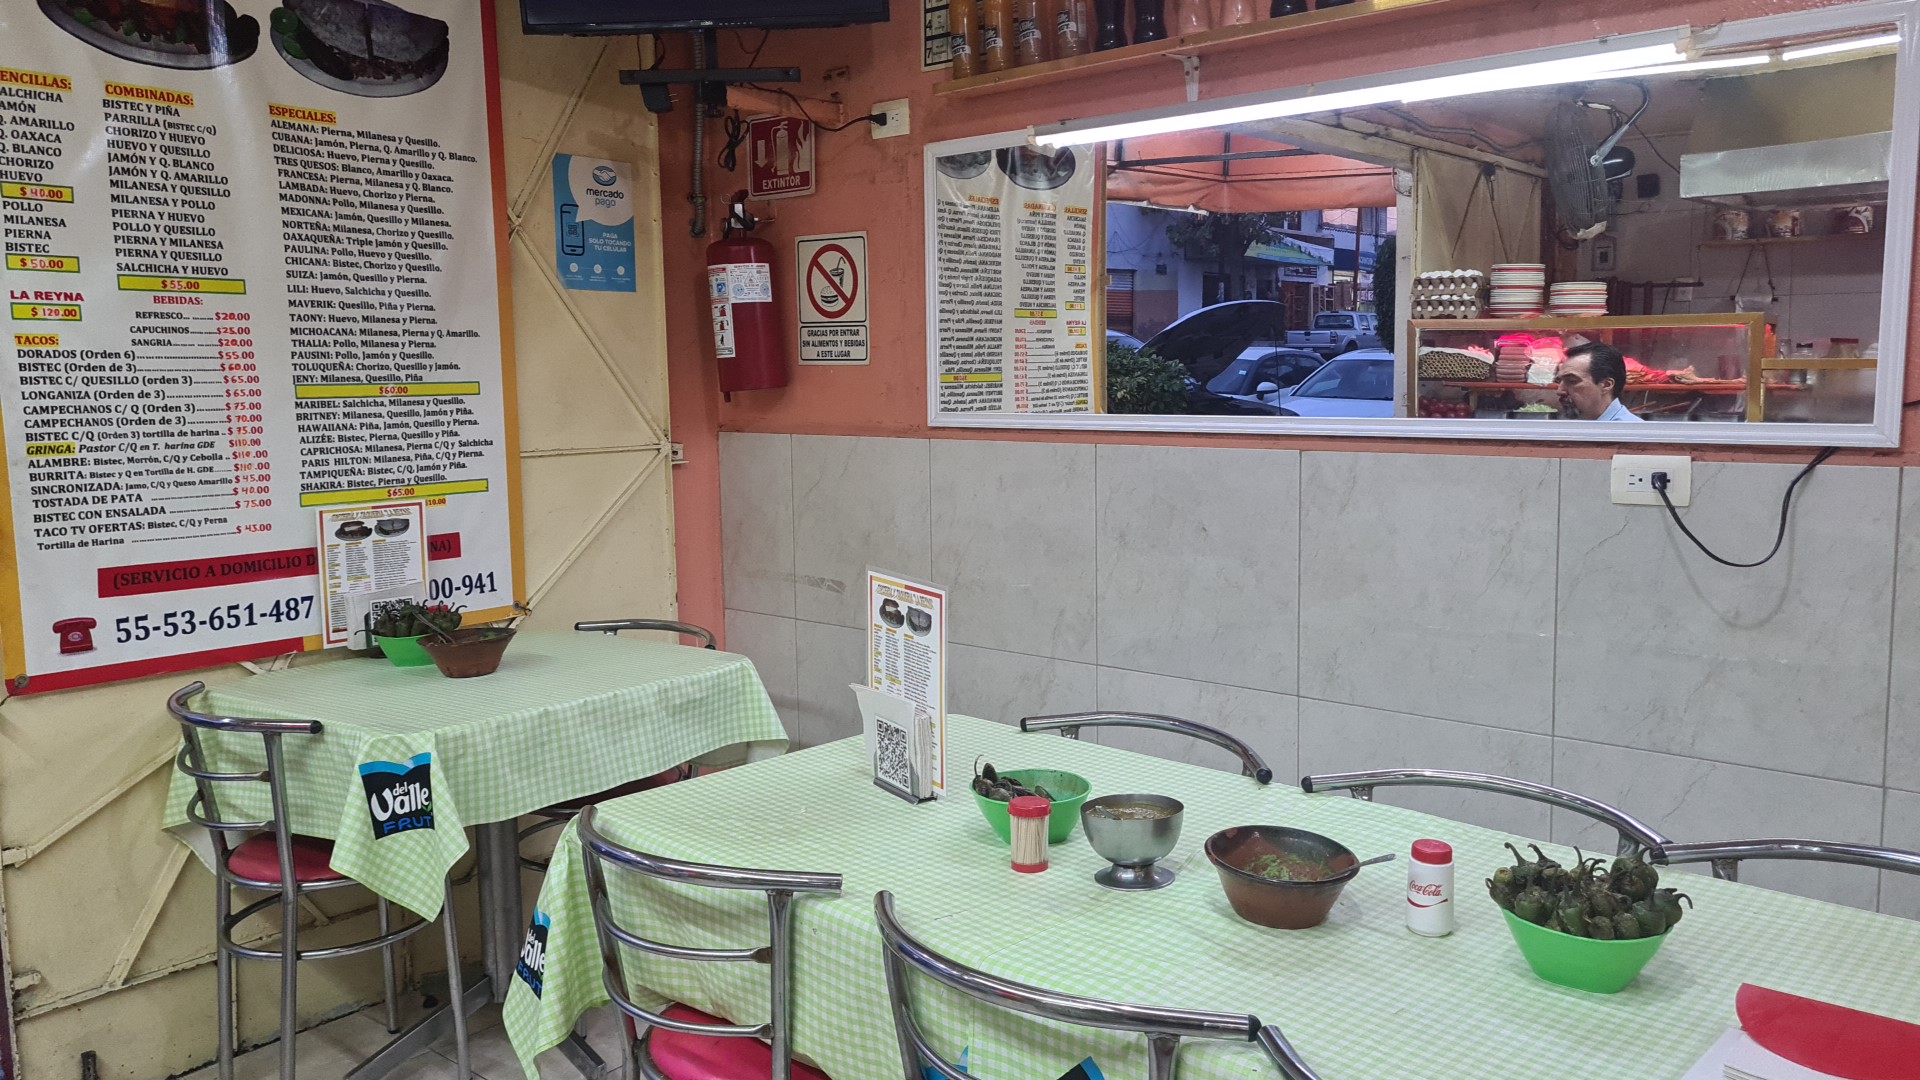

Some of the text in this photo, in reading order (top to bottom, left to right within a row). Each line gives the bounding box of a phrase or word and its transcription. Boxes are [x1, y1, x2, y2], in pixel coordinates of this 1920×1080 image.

[0, 70, 71, 90] ENCILLAS:
[0, 86, 63, 103] ALCHICHA
[105, 84, 194, 106] COMBINADAS:
[0, 100, 36, 114] AMÓN
[268, 105, 336, 124] ESPECIALES:
[10, 116, 75, 131] AMARILLO
[107, 139, 211, 158] HUEVO Y QUESILLO
[0, 156, 54, 170] CHORIZO
[108, 152, 215, 171] JAMÓN Y Q. BLANCO
[0, 170, 43, 183] HUEVO
[762, 175, 801, 190] EXTINTOR
[585, 187, 625, 200] mercado
[2, 200, 43, 213] POLLO
[110, 193, 215, 210] MILANESA Y POLLO
[279, 193, 444, 215] MADONNA: Pollo, Milanesa y Quesillo.
[594, 197, 617, 208] pago
[3, 214, 67, 228] MILANESA
[111, 208, 205, 223] PIERNA Y HUEVO
[4, 228, 52, 240] PIERNA
[112, 221, 216, 237] POLLO Y QUESILLO
[282, 220, 454, 240] NORTEÑA: Milanesa, Chorizo y Quesillo.
[5, 242, 50, 253] BISTEC
[116, 262, 228, 276] SALCHICHA Y HUEVO
[286, 270, 427, 284] SUIZA: Jamón, Quesillo y Pierna.
[10, 290, 84, 302] LA REYNA
[287, 284, 432, 299] LILI: Huevo, Salchicha y Quesillo.
[153, 295, 203, 305] BEBIDAS:
[289, 313, 438, 326] TAONY: Huevo, Milanesa y Pierna.
[14, 335, 59, 345] TACOS:
[807, 329, 860, 337] GRACIAS POR ENTRAR
[291, 339, 436, 350] THALIA: Pollo, Milanesa y Pierna.
[802, 340, 810, 348] SIN
[811, 339, 838, 348] ALIMENTOS
[844, 339, 866, 348] BEBIDAS
[17, 349, 136, 361] DORADOS (Orden 6)
[816, 350, 851, 358] A ESTE LUGAR
[18, 362, 137, 374] BISTEC (Orden de 3)
[21, 389, 166, 402] LONGANIZA (Orden de 3)
[295, 397, 466, 409] MARIBEL: Salchicha, Milanesa y Quesillo.
[24, 415, 186, 429] CAMPECHANOS (Orden de 3)
[26, 444, 76, 455] GRINGA:
[32, 493, 143, 508] TOSTADA DE PATA
[33, 506, 167, 523] BISTEC CON ENSALADA
[37, 537, 125, 551] Tortilla de Harina
[430, 540, 452, 553] NA)
[112, 565, 200, 591] (SERVICIO
[206, 563, 217, 577] A
[220, 555, 302, 576] DOMICILIO
[429, 571, 497, 601] 00-941
[116, 595, 314, 643] 55-53-651-487
[393, 782, 408, 796] del
[371, 782, 430, 822] Valle
[383, 816, 432, 834] FRUT
